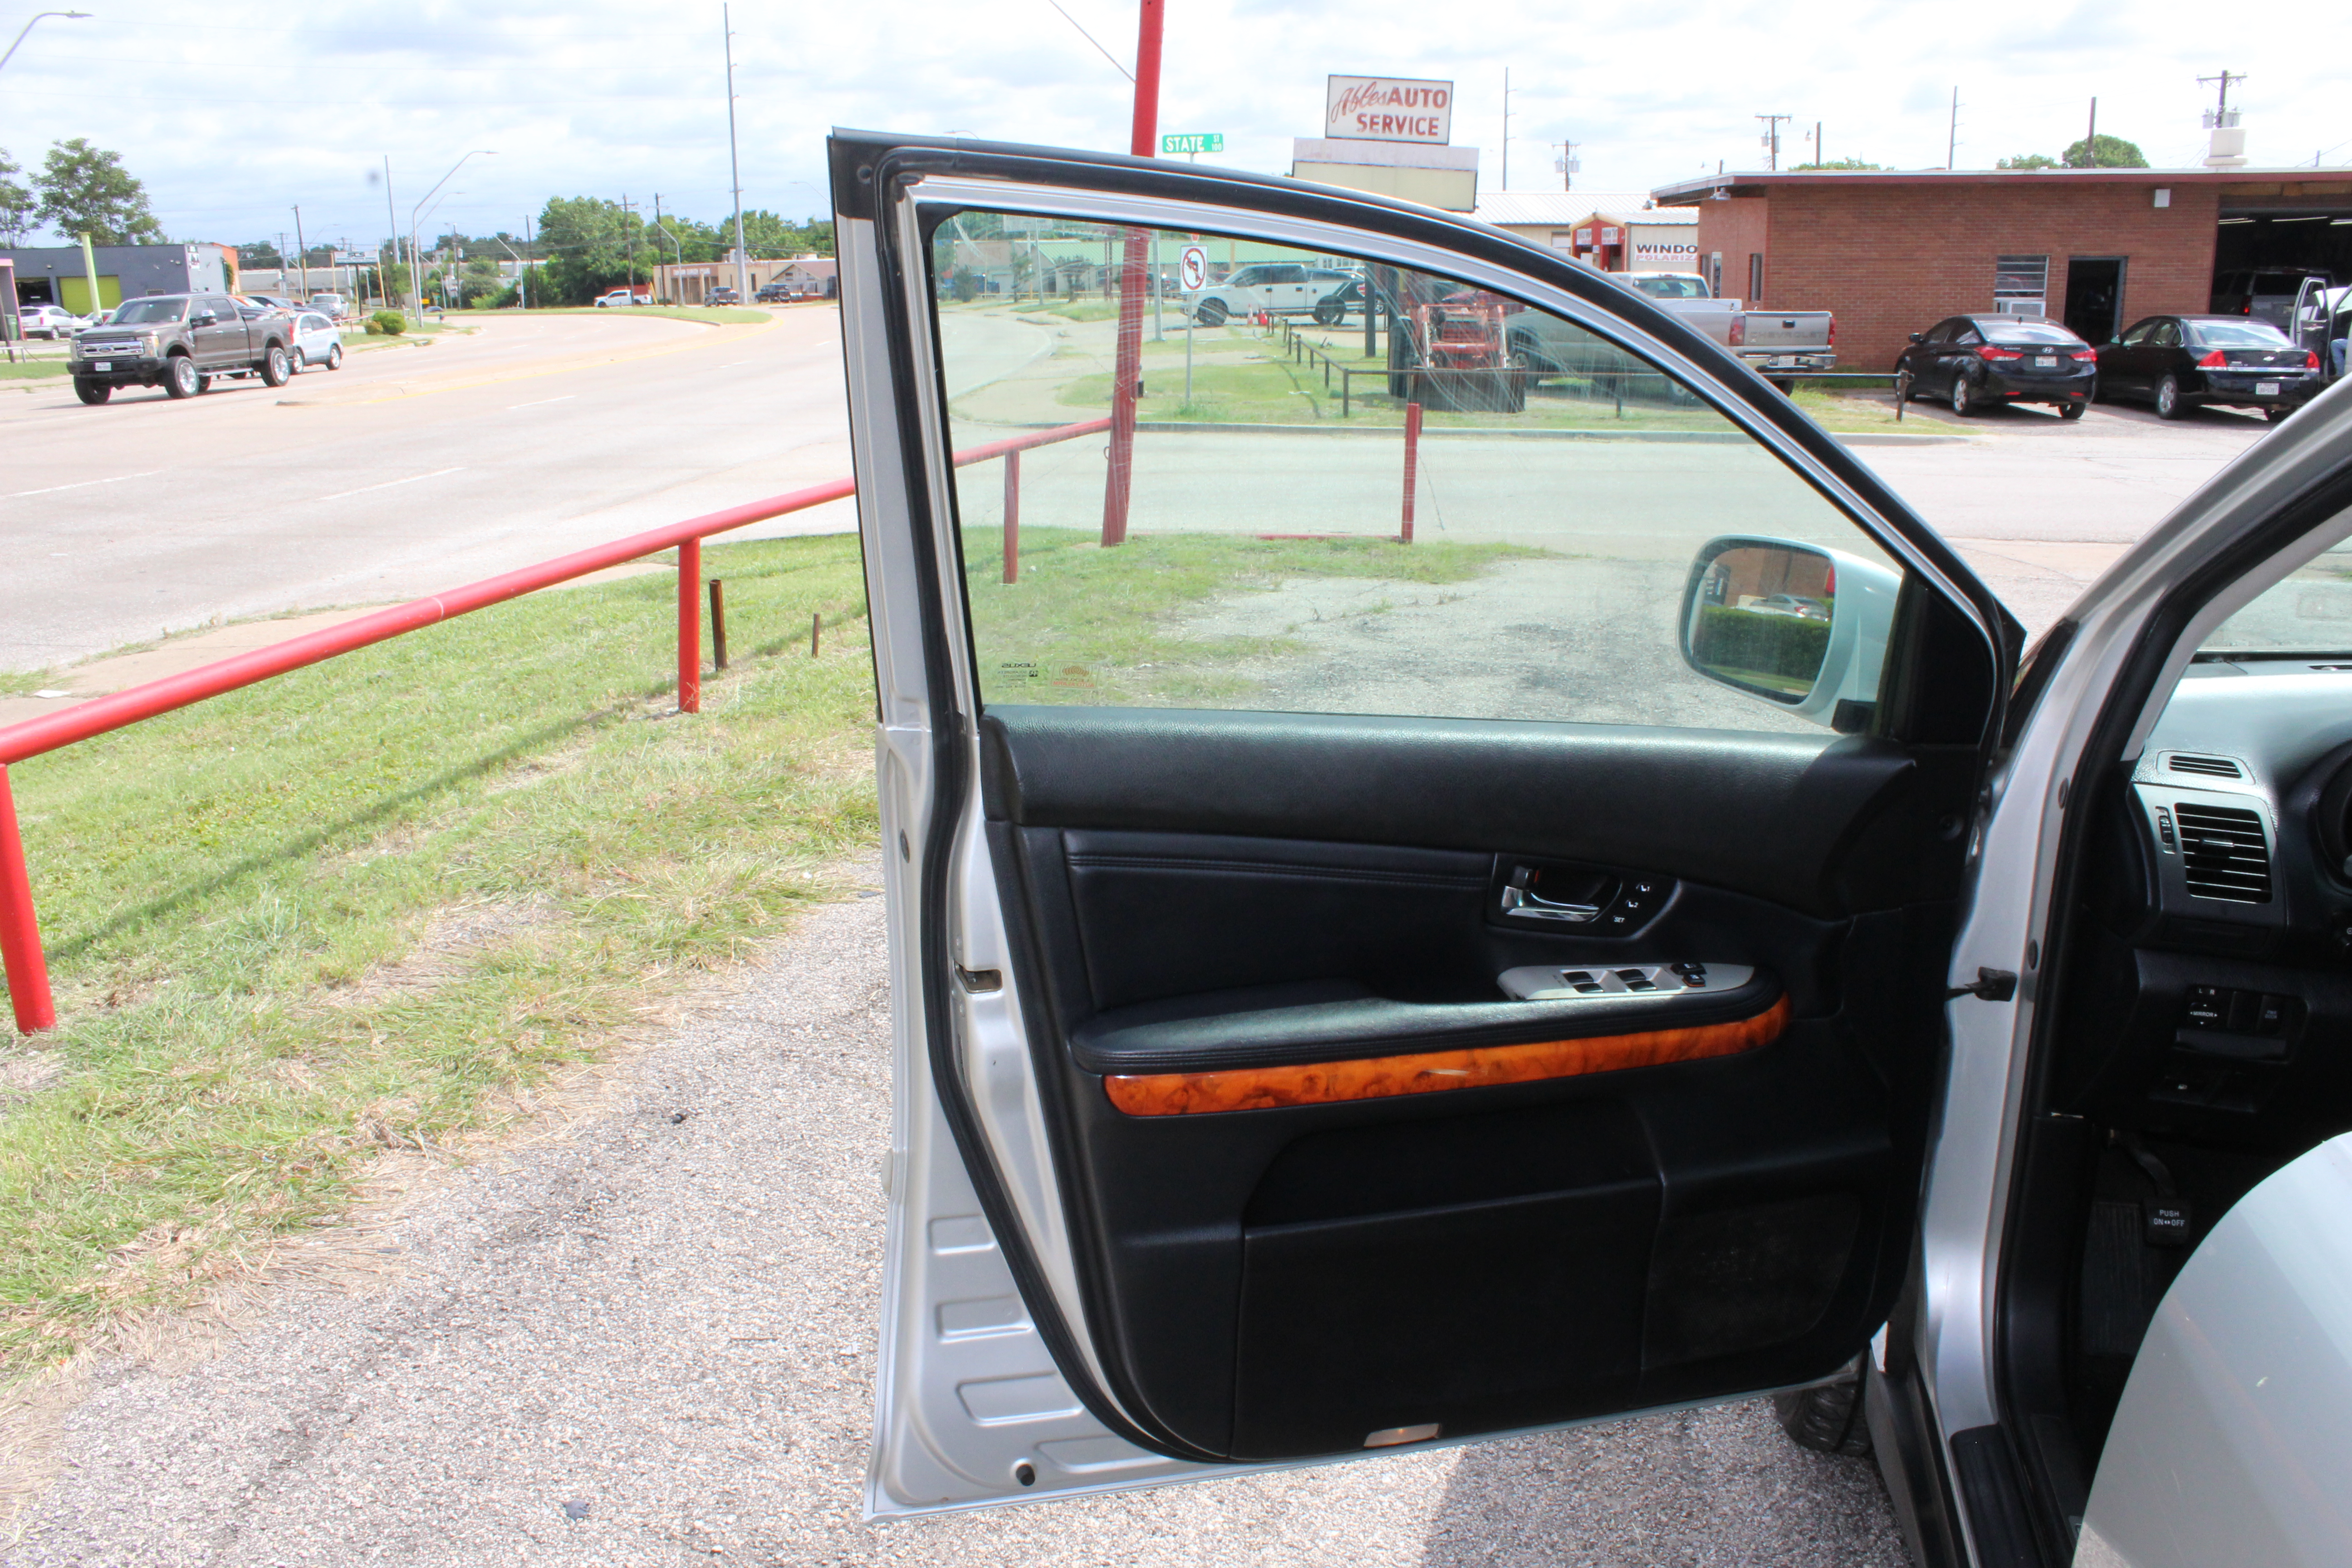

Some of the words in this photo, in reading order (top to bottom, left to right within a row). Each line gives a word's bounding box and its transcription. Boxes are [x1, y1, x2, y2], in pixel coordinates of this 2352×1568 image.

[1331, 81, 1387, 123] Ables
[1386, 86, 1447, 108] AUTO
[1356, 113, 1439, 136] SERVICE
[1213, 134, 1220, 142] ST
[1166, 136, 1205, 152] STATE
[1212, 143, 1222, 151] 100
[1636, 244, 1698, 254] WINDO
[2171, 1219, 2185, 1227] OFF
